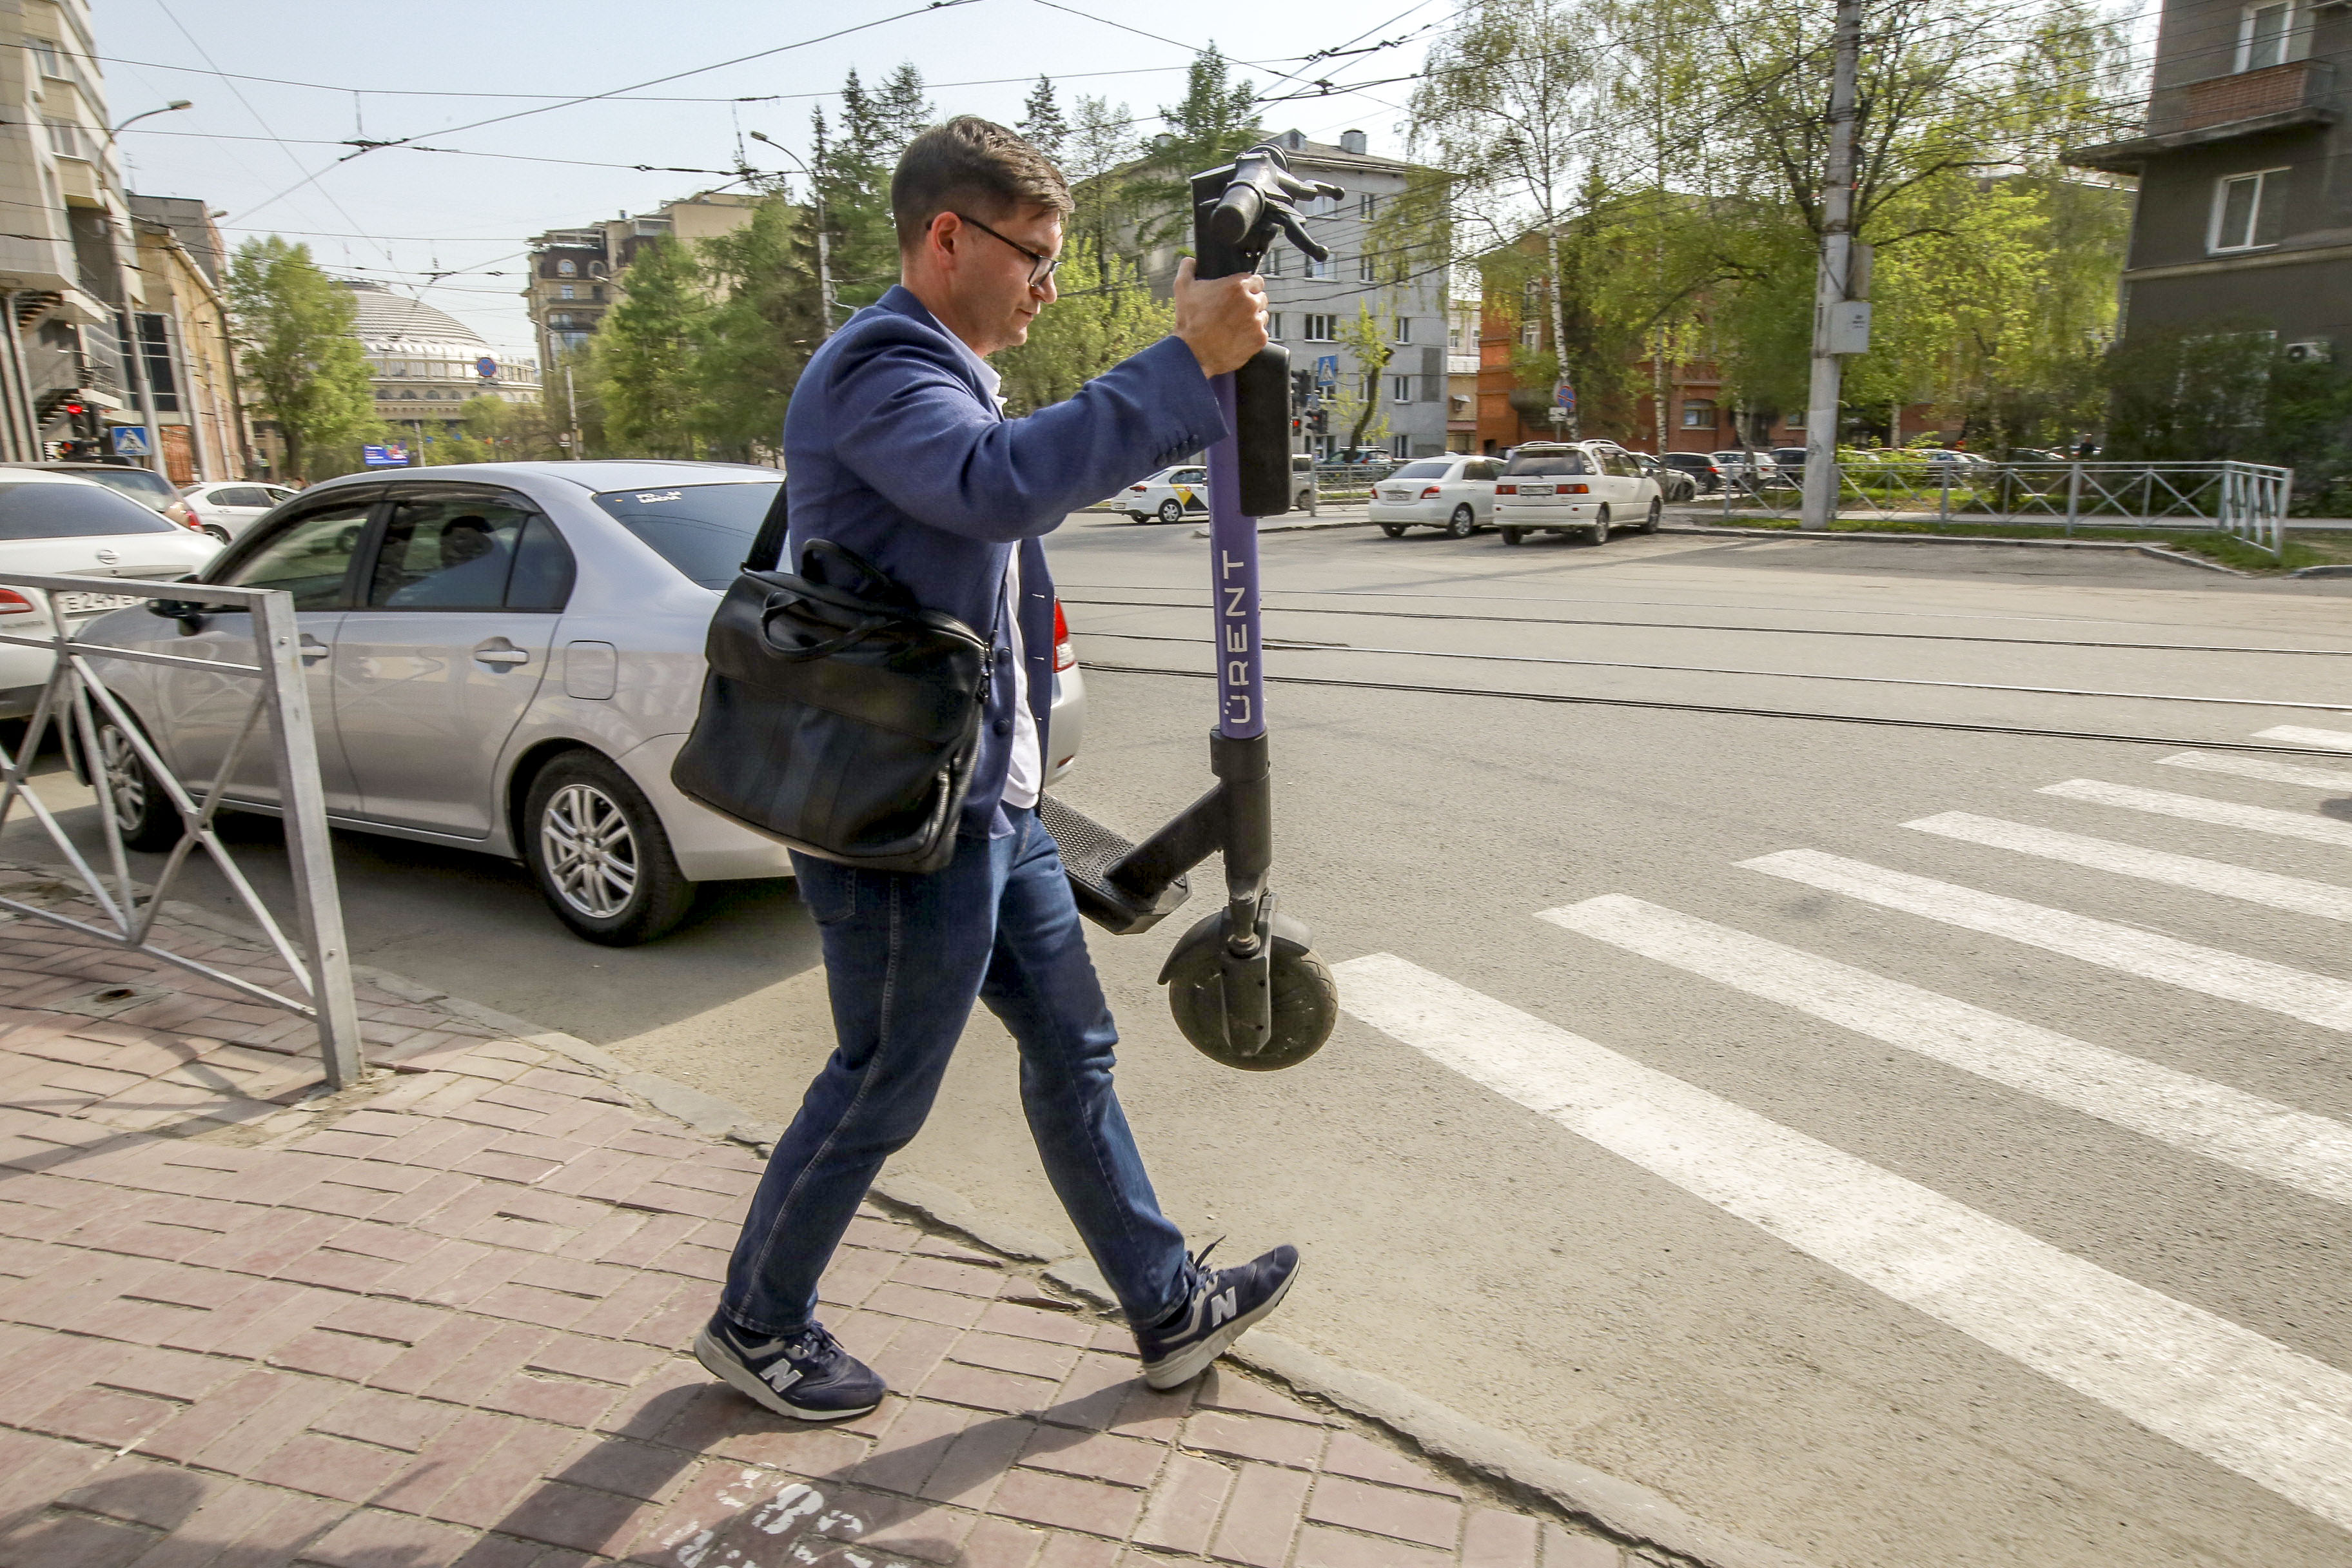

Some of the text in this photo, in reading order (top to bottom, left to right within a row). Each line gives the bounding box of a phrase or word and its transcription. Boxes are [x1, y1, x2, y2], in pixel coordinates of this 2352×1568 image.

[1222, 549, 1251, 723] ÜRENT
[1211, 1286, 1237, 1328] N
[759, 1358, 803, 1393] N
